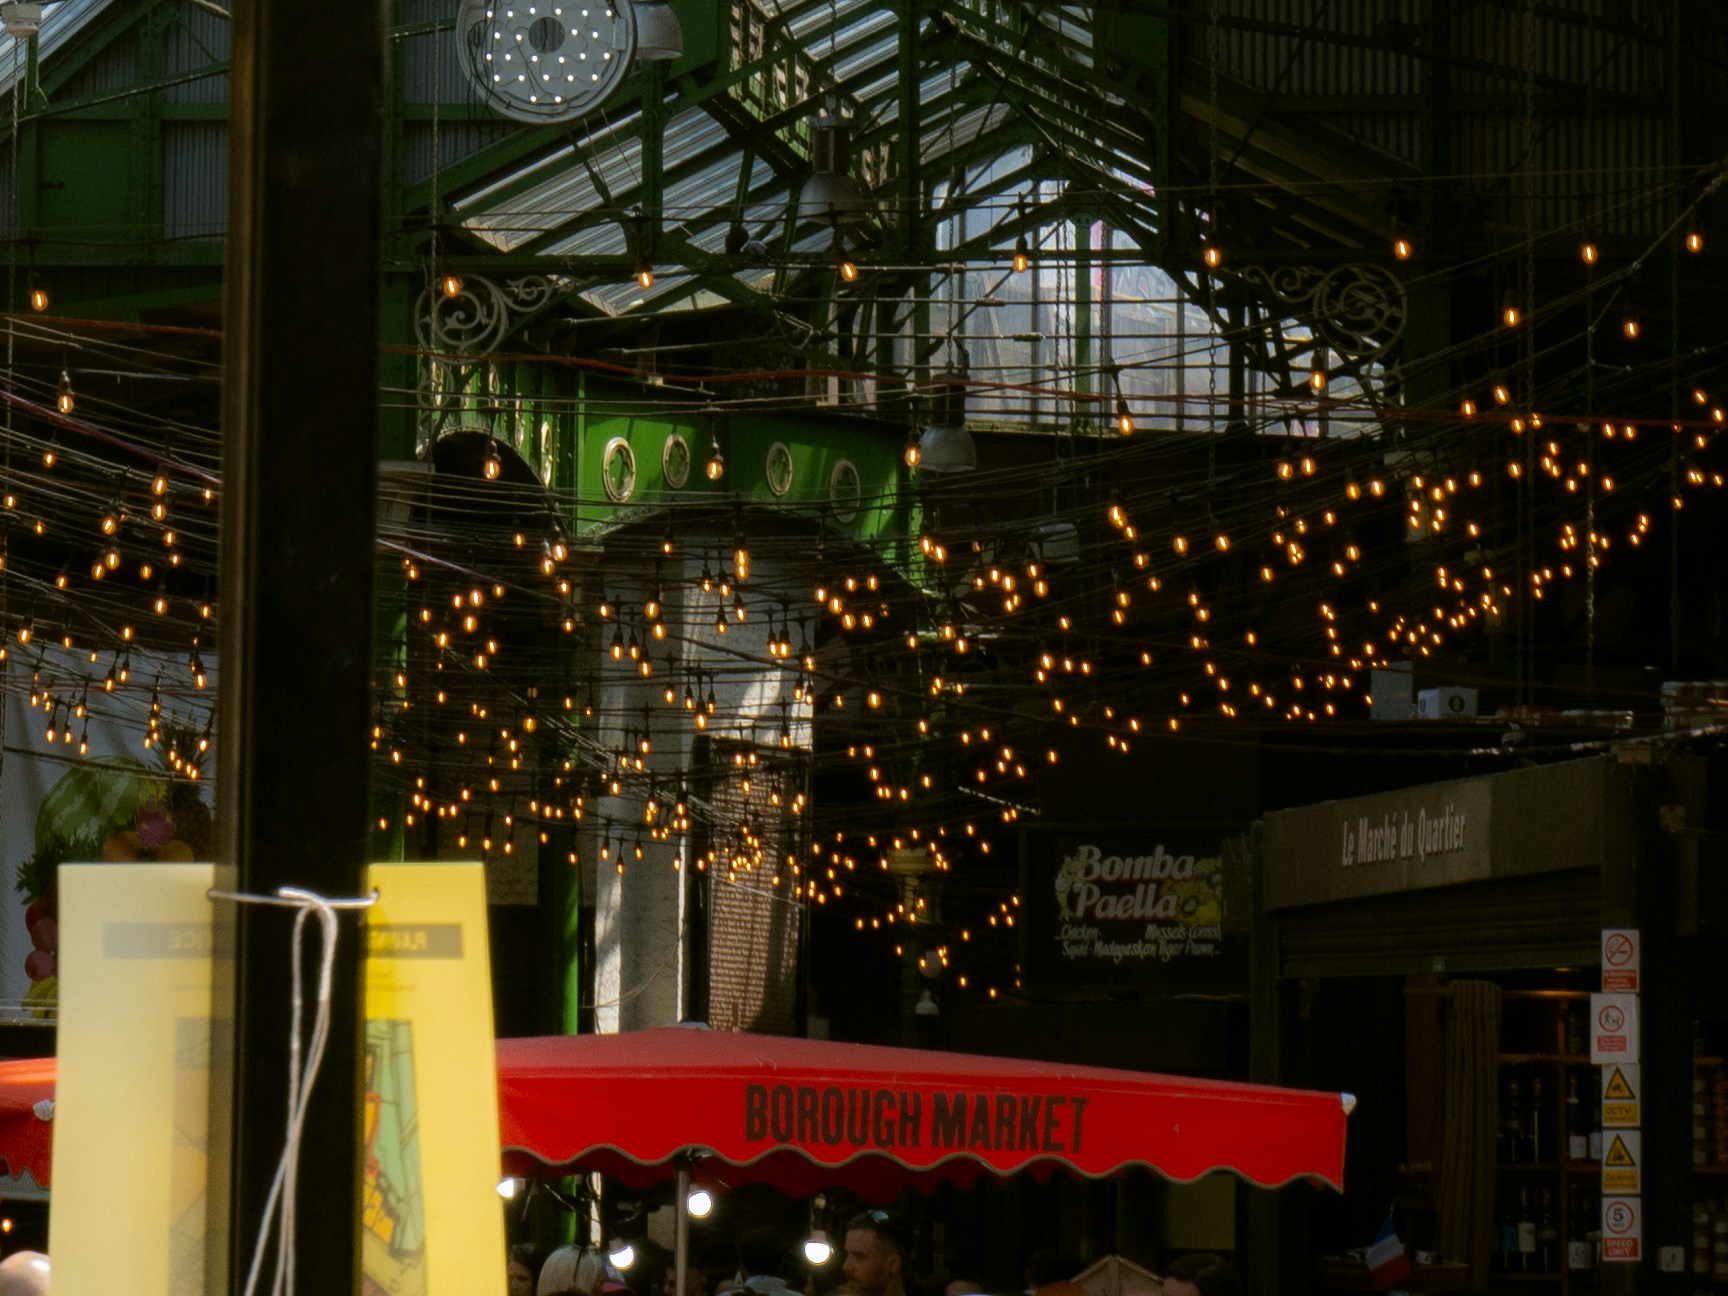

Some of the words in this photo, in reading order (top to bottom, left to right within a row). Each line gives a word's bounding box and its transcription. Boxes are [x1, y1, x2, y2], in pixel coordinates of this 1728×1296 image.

[1342, 821, 1354, 866] Le
[1358, 812, 1397, 864] Marché
[1400, 811, 1414, 857] du
[1418, 802, 1465, 863] Quartier
[1076, 844, 1194, 881] Bomba
[1072, 883, 1178, 920] Paella
[745, 1084, 921, 1148] BOROUGH
[931, 1093, 1089, 1154] MARKET
[1613, 1207, 1624, 1222] 5
